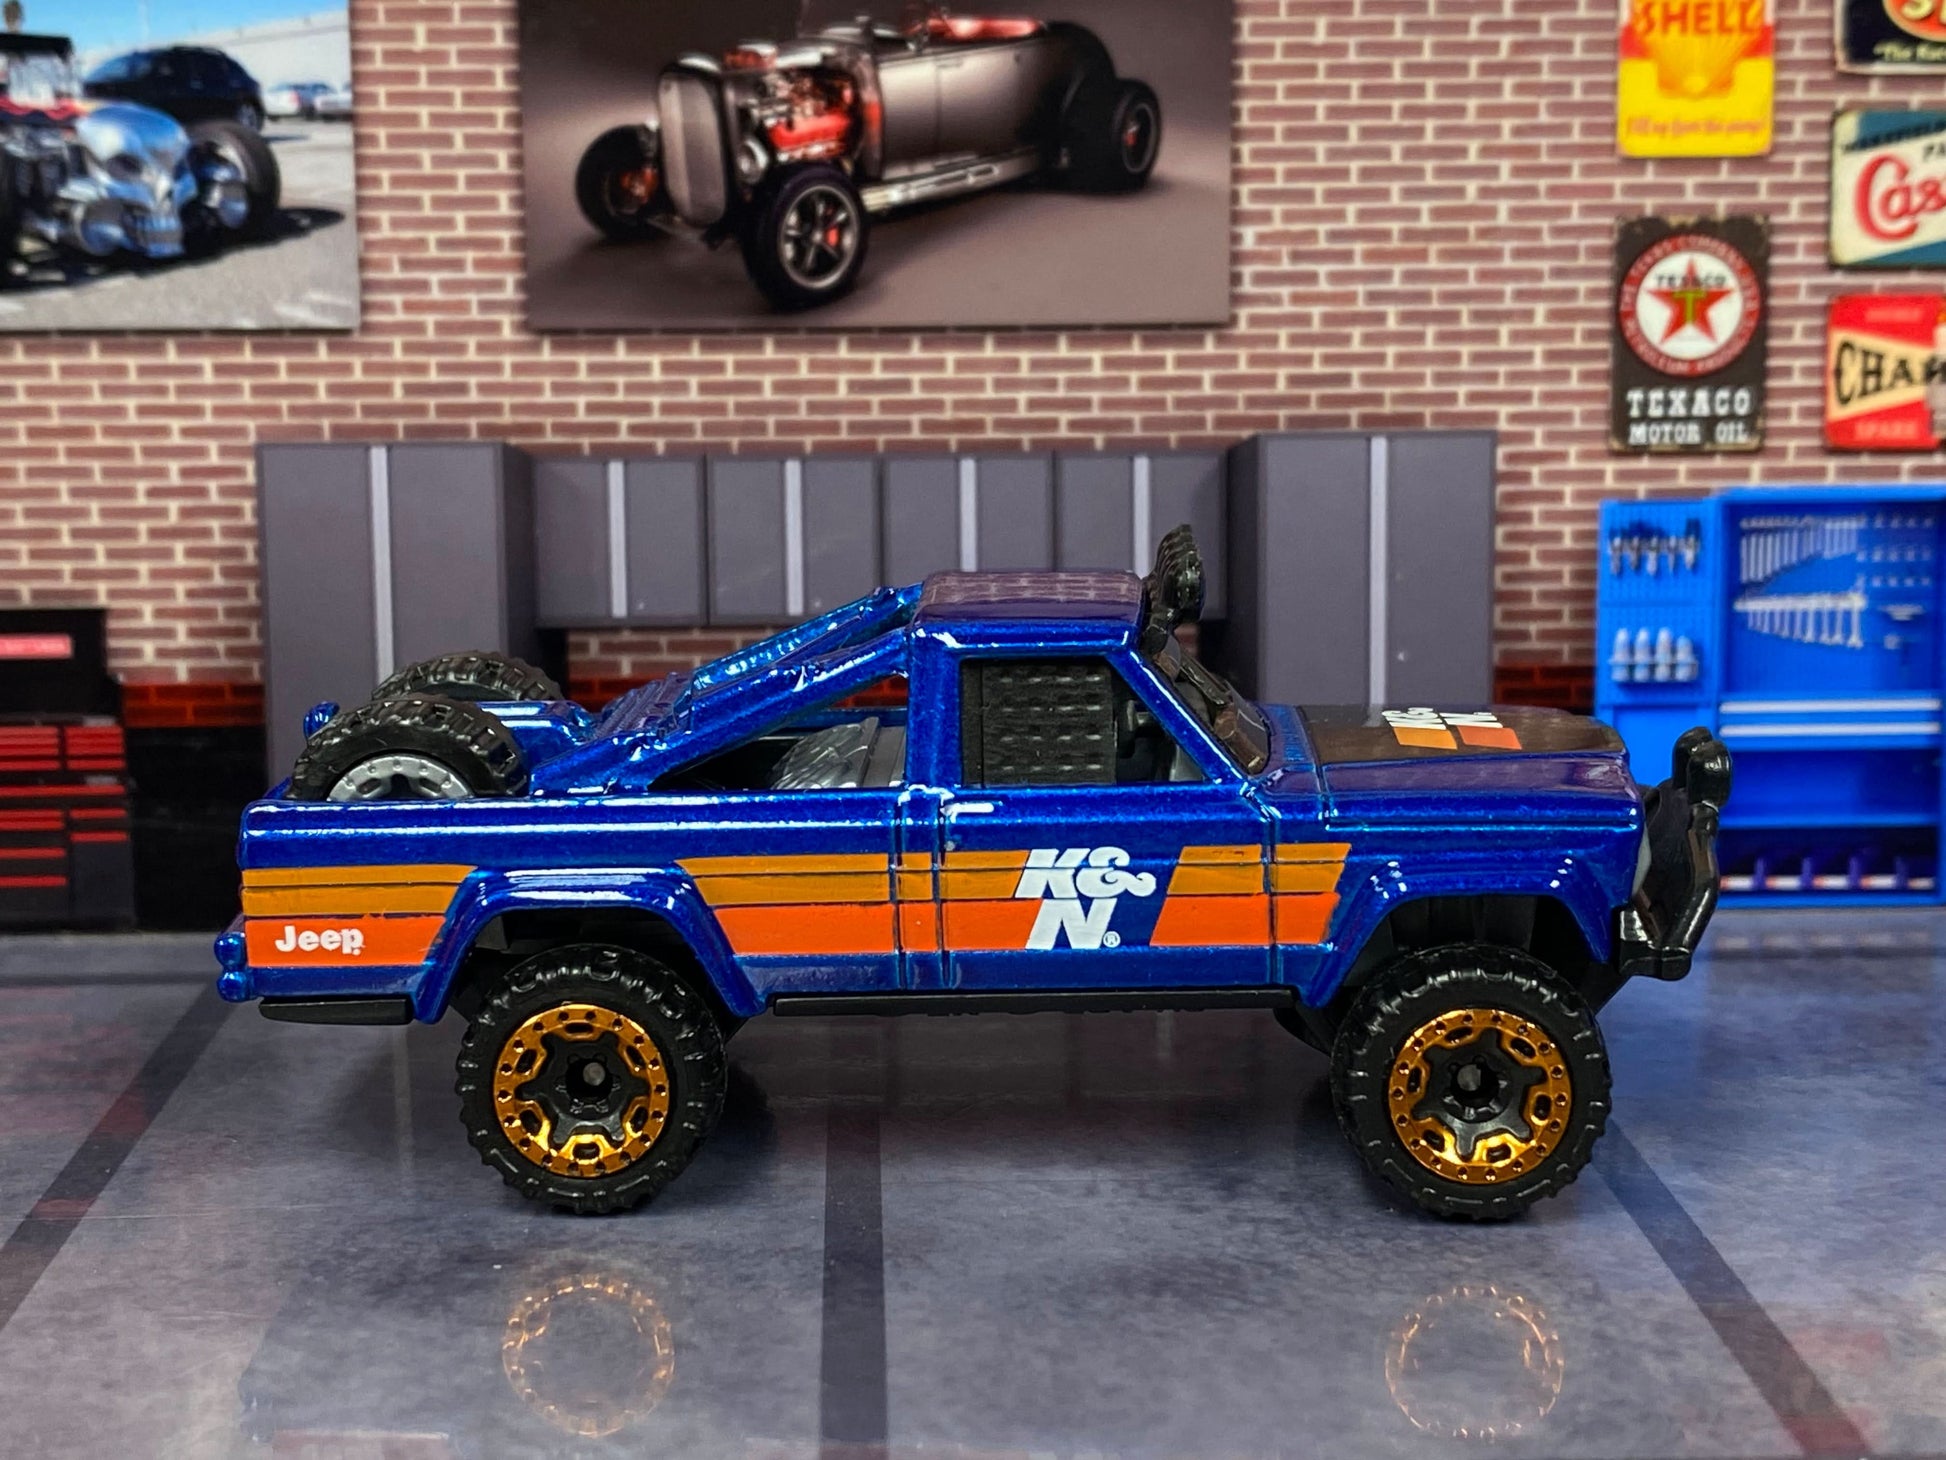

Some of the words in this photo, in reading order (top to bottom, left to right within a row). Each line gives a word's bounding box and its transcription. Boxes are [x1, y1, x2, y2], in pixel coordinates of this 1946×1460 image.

[1634, 1, 1760, 35] SHELL
[1626, 388, 1750, 418] TEXACO
[1628, 421, 1701, 445] MOTOR
[1714, 420, 1749, 443] OIL
